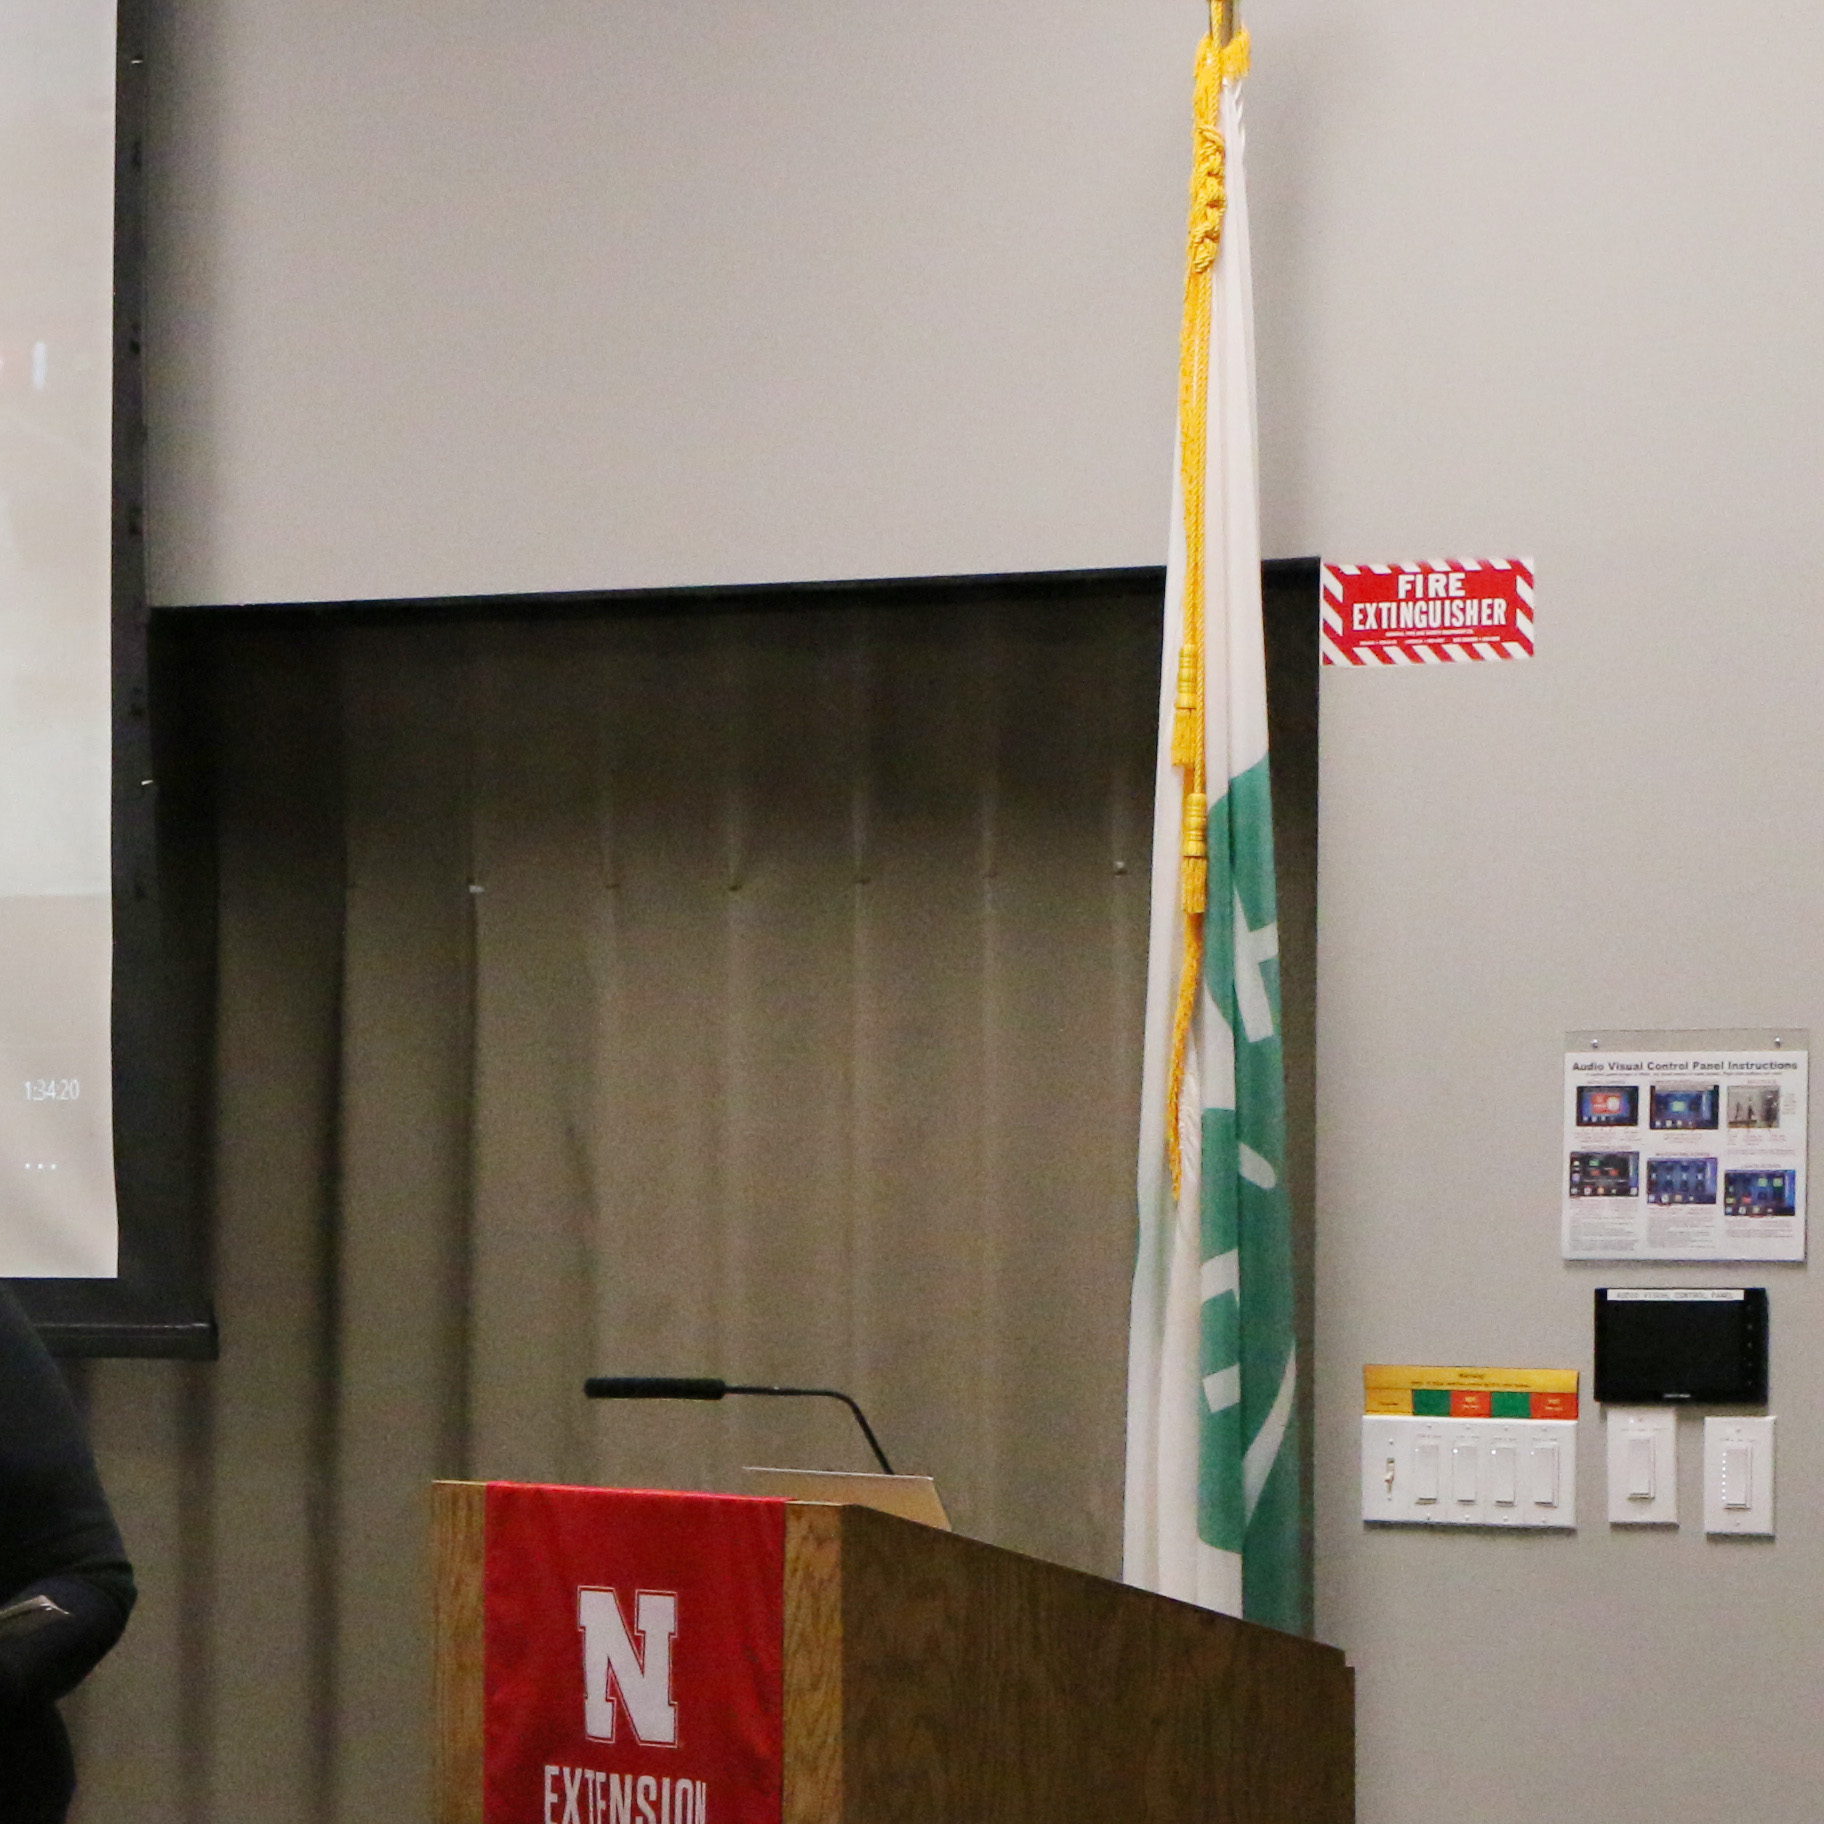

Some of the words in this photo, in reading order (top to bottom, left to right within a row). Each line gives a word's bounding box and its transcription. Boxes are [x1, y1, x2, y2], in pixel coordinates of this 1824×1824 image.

[1398, 572, 1466, 599] FIRE
[1352, 598, 1507, 630] EXTINGUISHER
[1573, 1062, 1605, 1071] Audio
[1608, 1062, 1643, 1071] Visual
[1647, 1062, 1689, 1071] Control
[1692, 1062, 1724, 1071] Panel
[1728, 1061, 1798, 1071] Instructions
[576, 1585, 679, 1748] N
